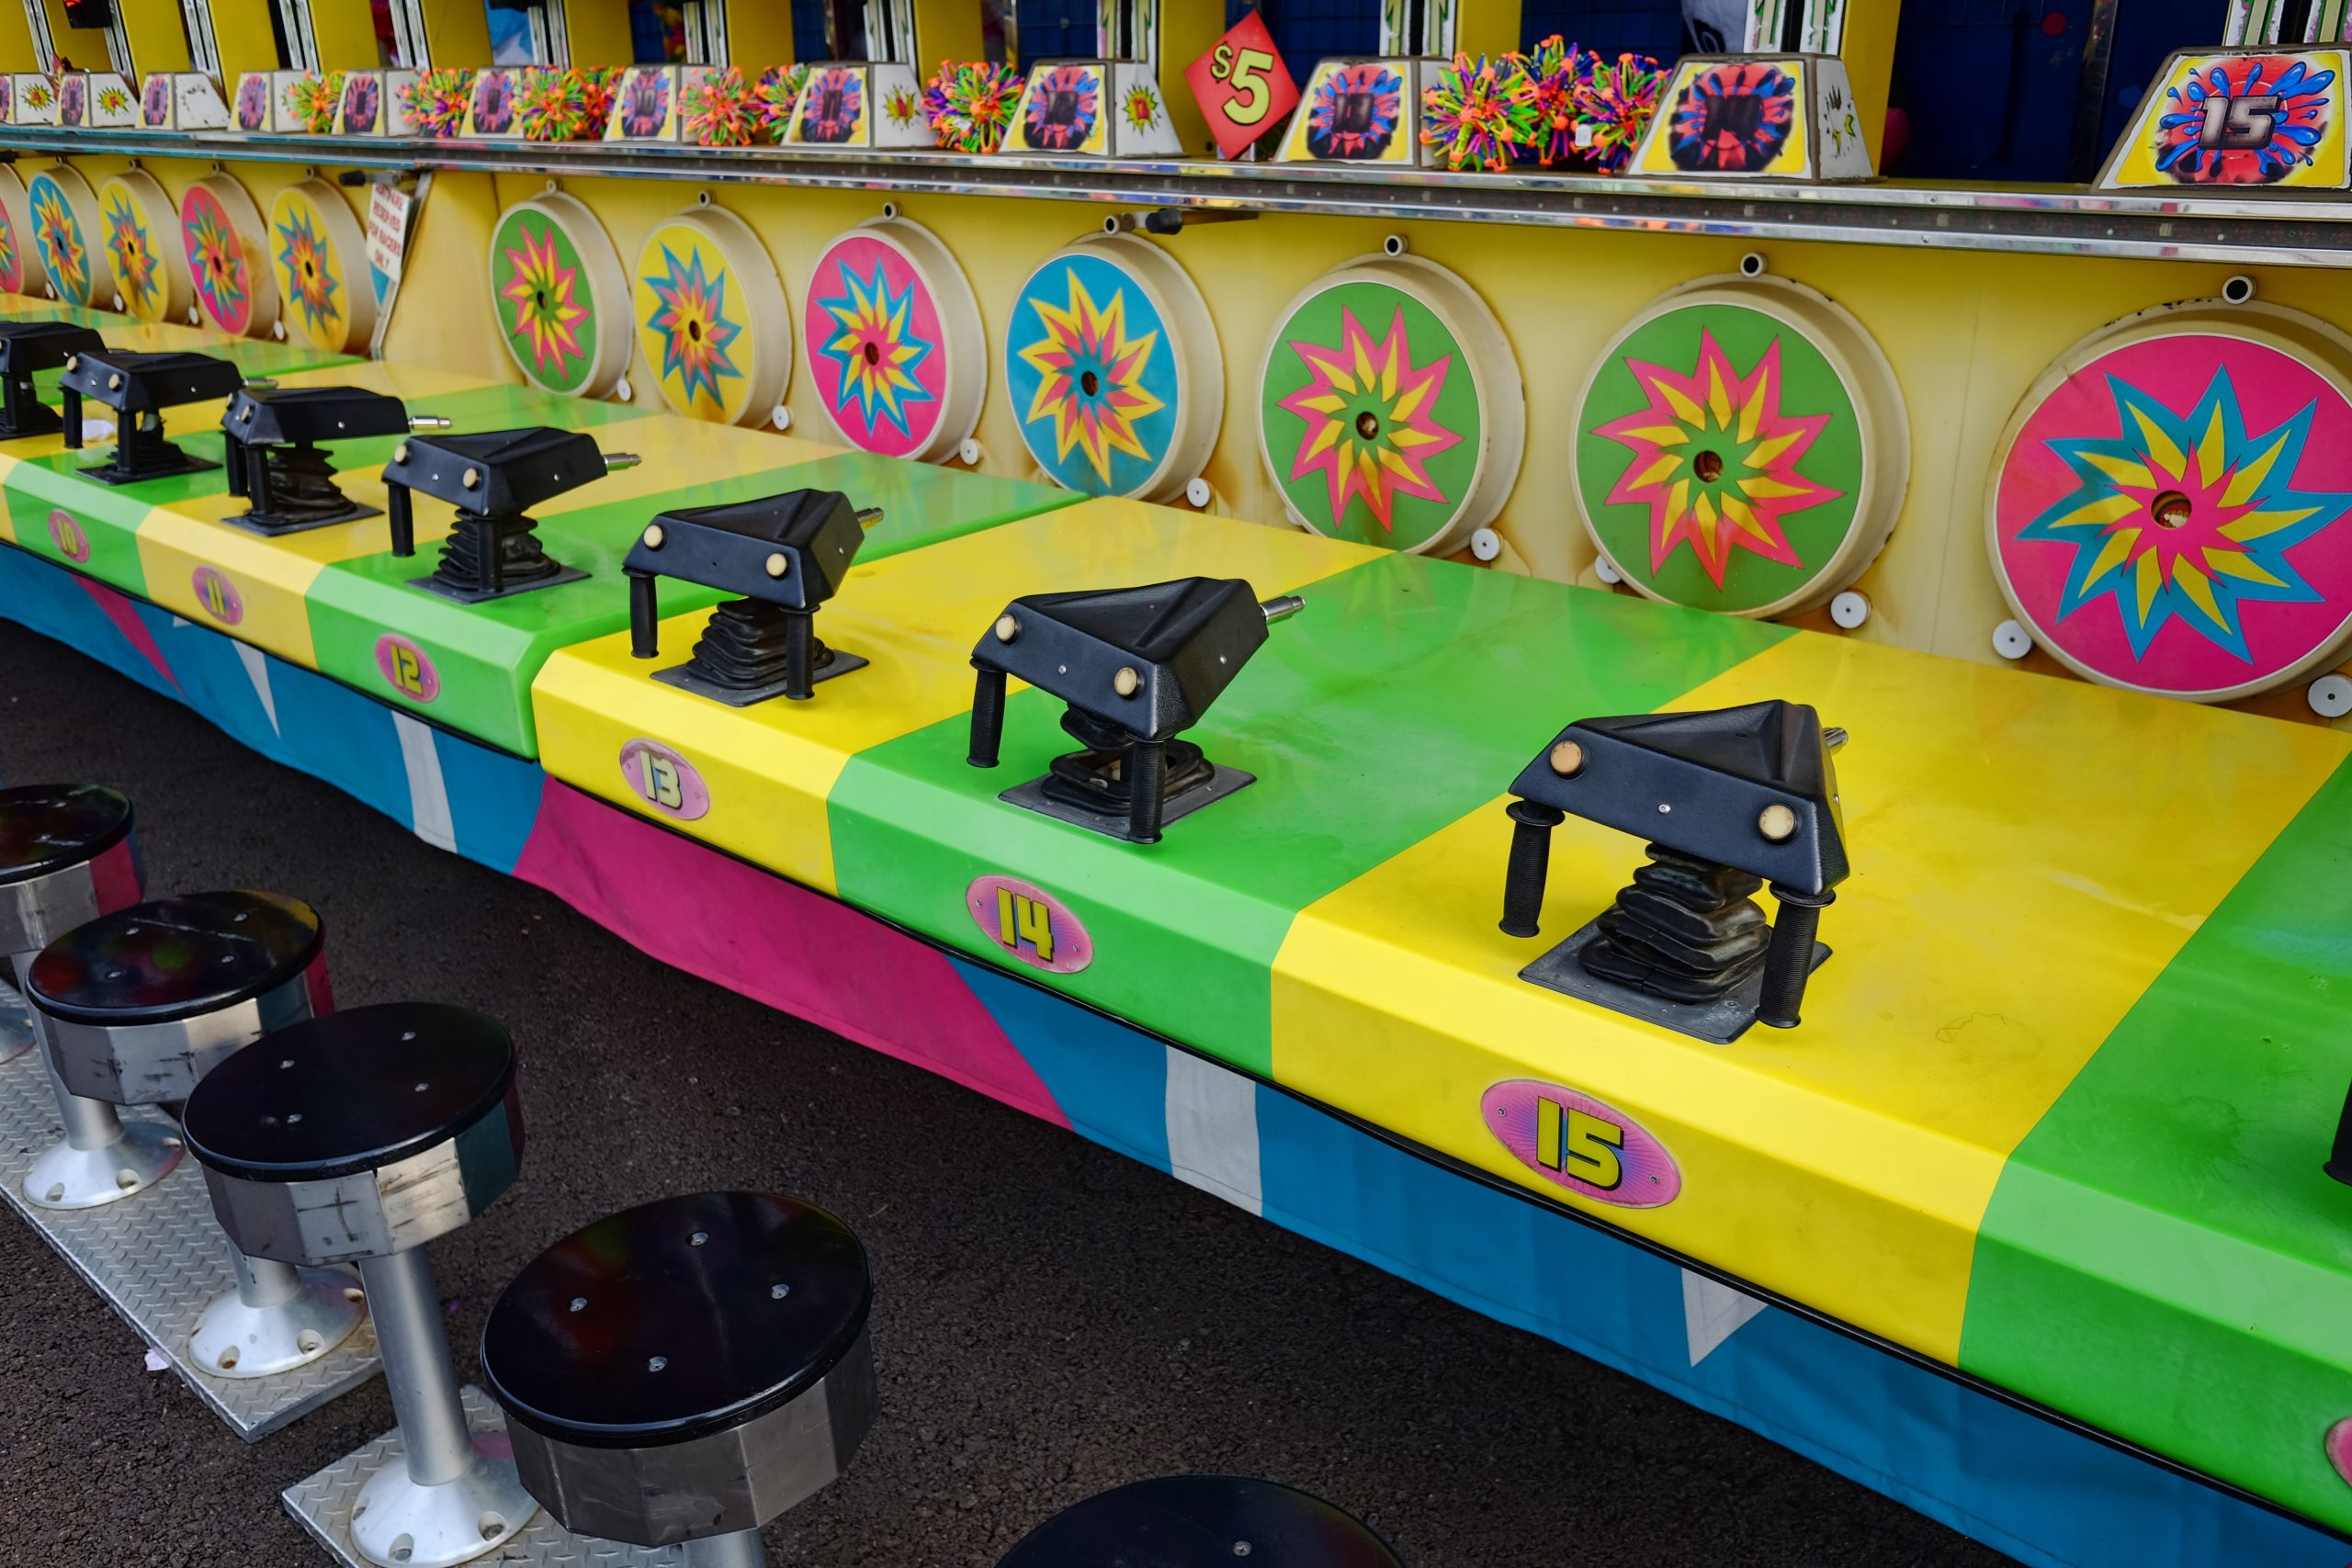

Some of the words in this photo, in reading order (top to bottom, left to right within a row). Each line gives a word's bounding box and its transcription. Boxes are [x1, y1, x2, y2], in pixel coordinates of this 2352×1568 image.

[1210, 41, 1274, 126] $5
[2198, 94, 2282, 150] 15
[56, 518, 79, 557] 10
[205, 575, 228, 618] 11
[390, 643, 424, 696] 12
[639, 750, 683, 810] 13
[997, 886, 1055, 963] 14
[1536, 1096, 1624, 1191] 15
